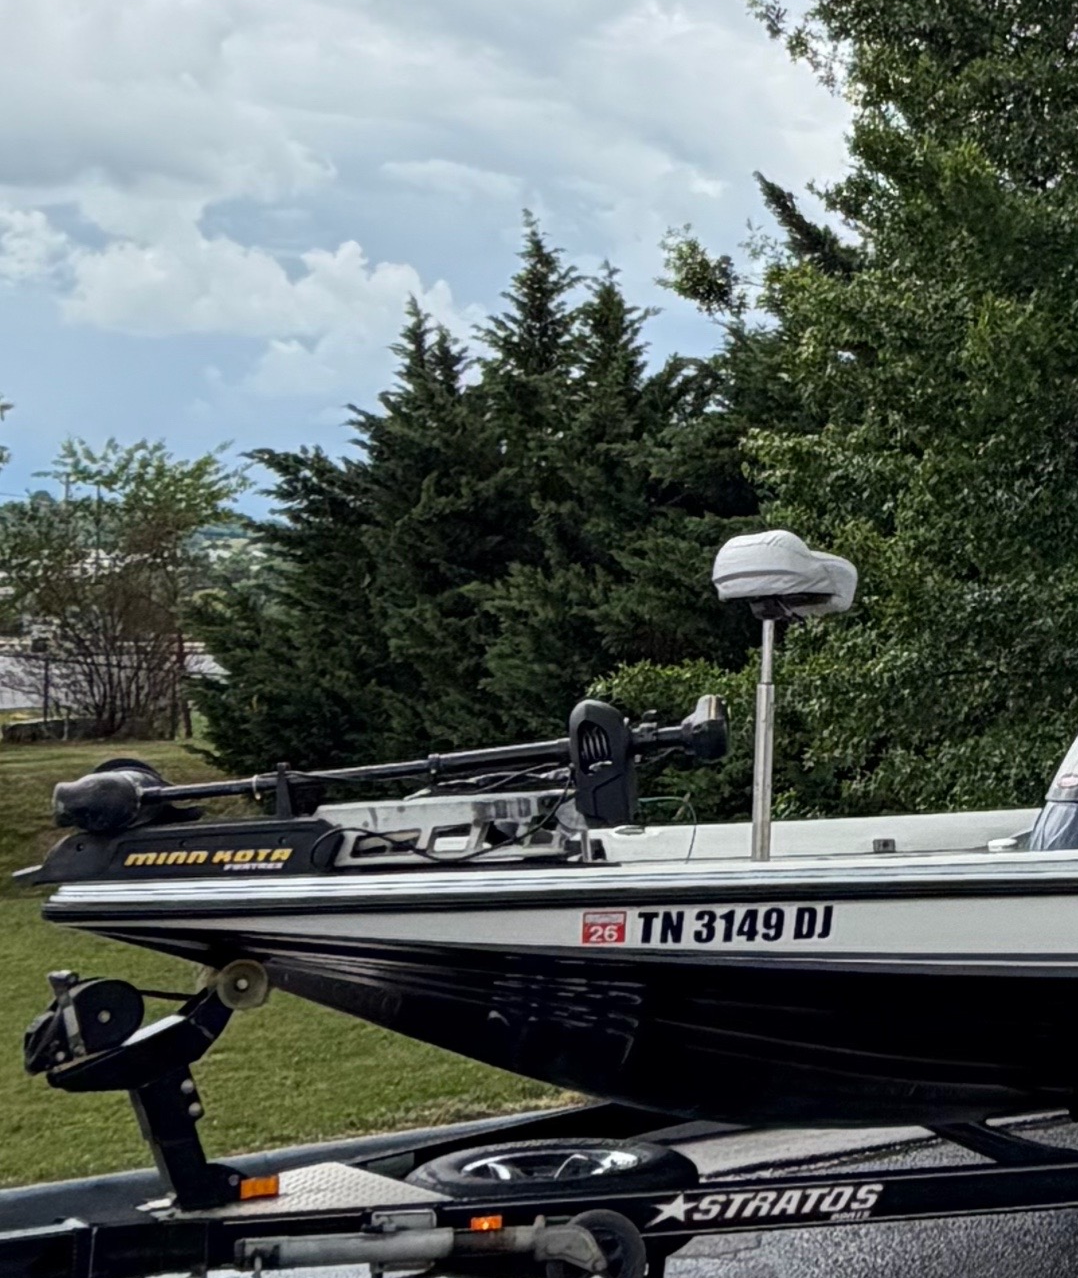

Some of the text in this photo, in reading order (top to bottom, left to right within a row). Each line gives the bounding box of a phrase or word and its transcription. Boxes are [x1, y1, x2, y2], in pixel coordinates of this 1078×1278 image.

[124, 848, 293, 866] MINN KOTA
[589, 925, 619, 942] 26
[638, 905, 833, 944] TN 3149 DJ
[693, 1184, 884, 1221] STRATOS
